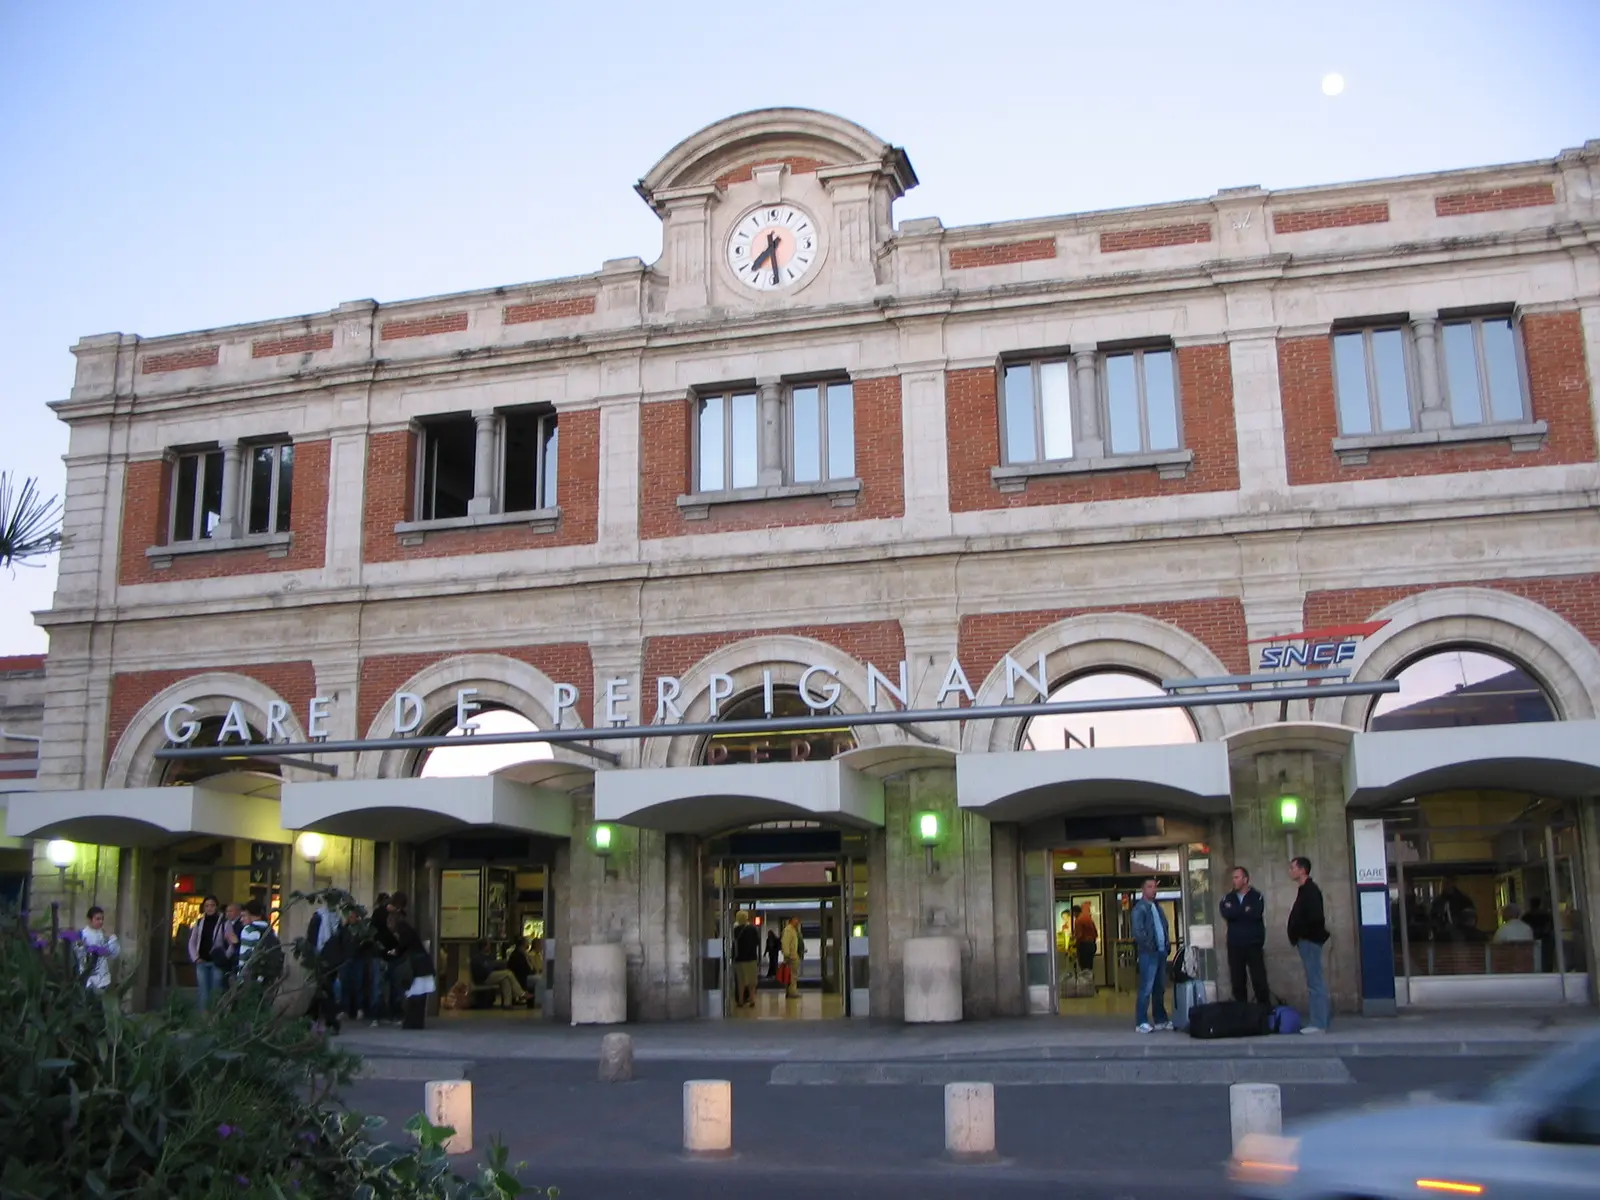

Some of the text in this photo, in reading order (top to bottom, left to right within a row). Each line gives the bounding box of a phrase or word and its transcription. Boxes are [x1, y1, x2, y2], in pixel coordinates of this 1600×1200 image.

[767, 209, 780, 222] 12
[803, 236, 812, 249] 3
[735, 245, 744, 257] 9
[1259, 641, 1357, 669] SNCF
[164, 652, 1048, 743] GARE DE PERPIGNAN
[1358, 868, 1384, 878] GARE
